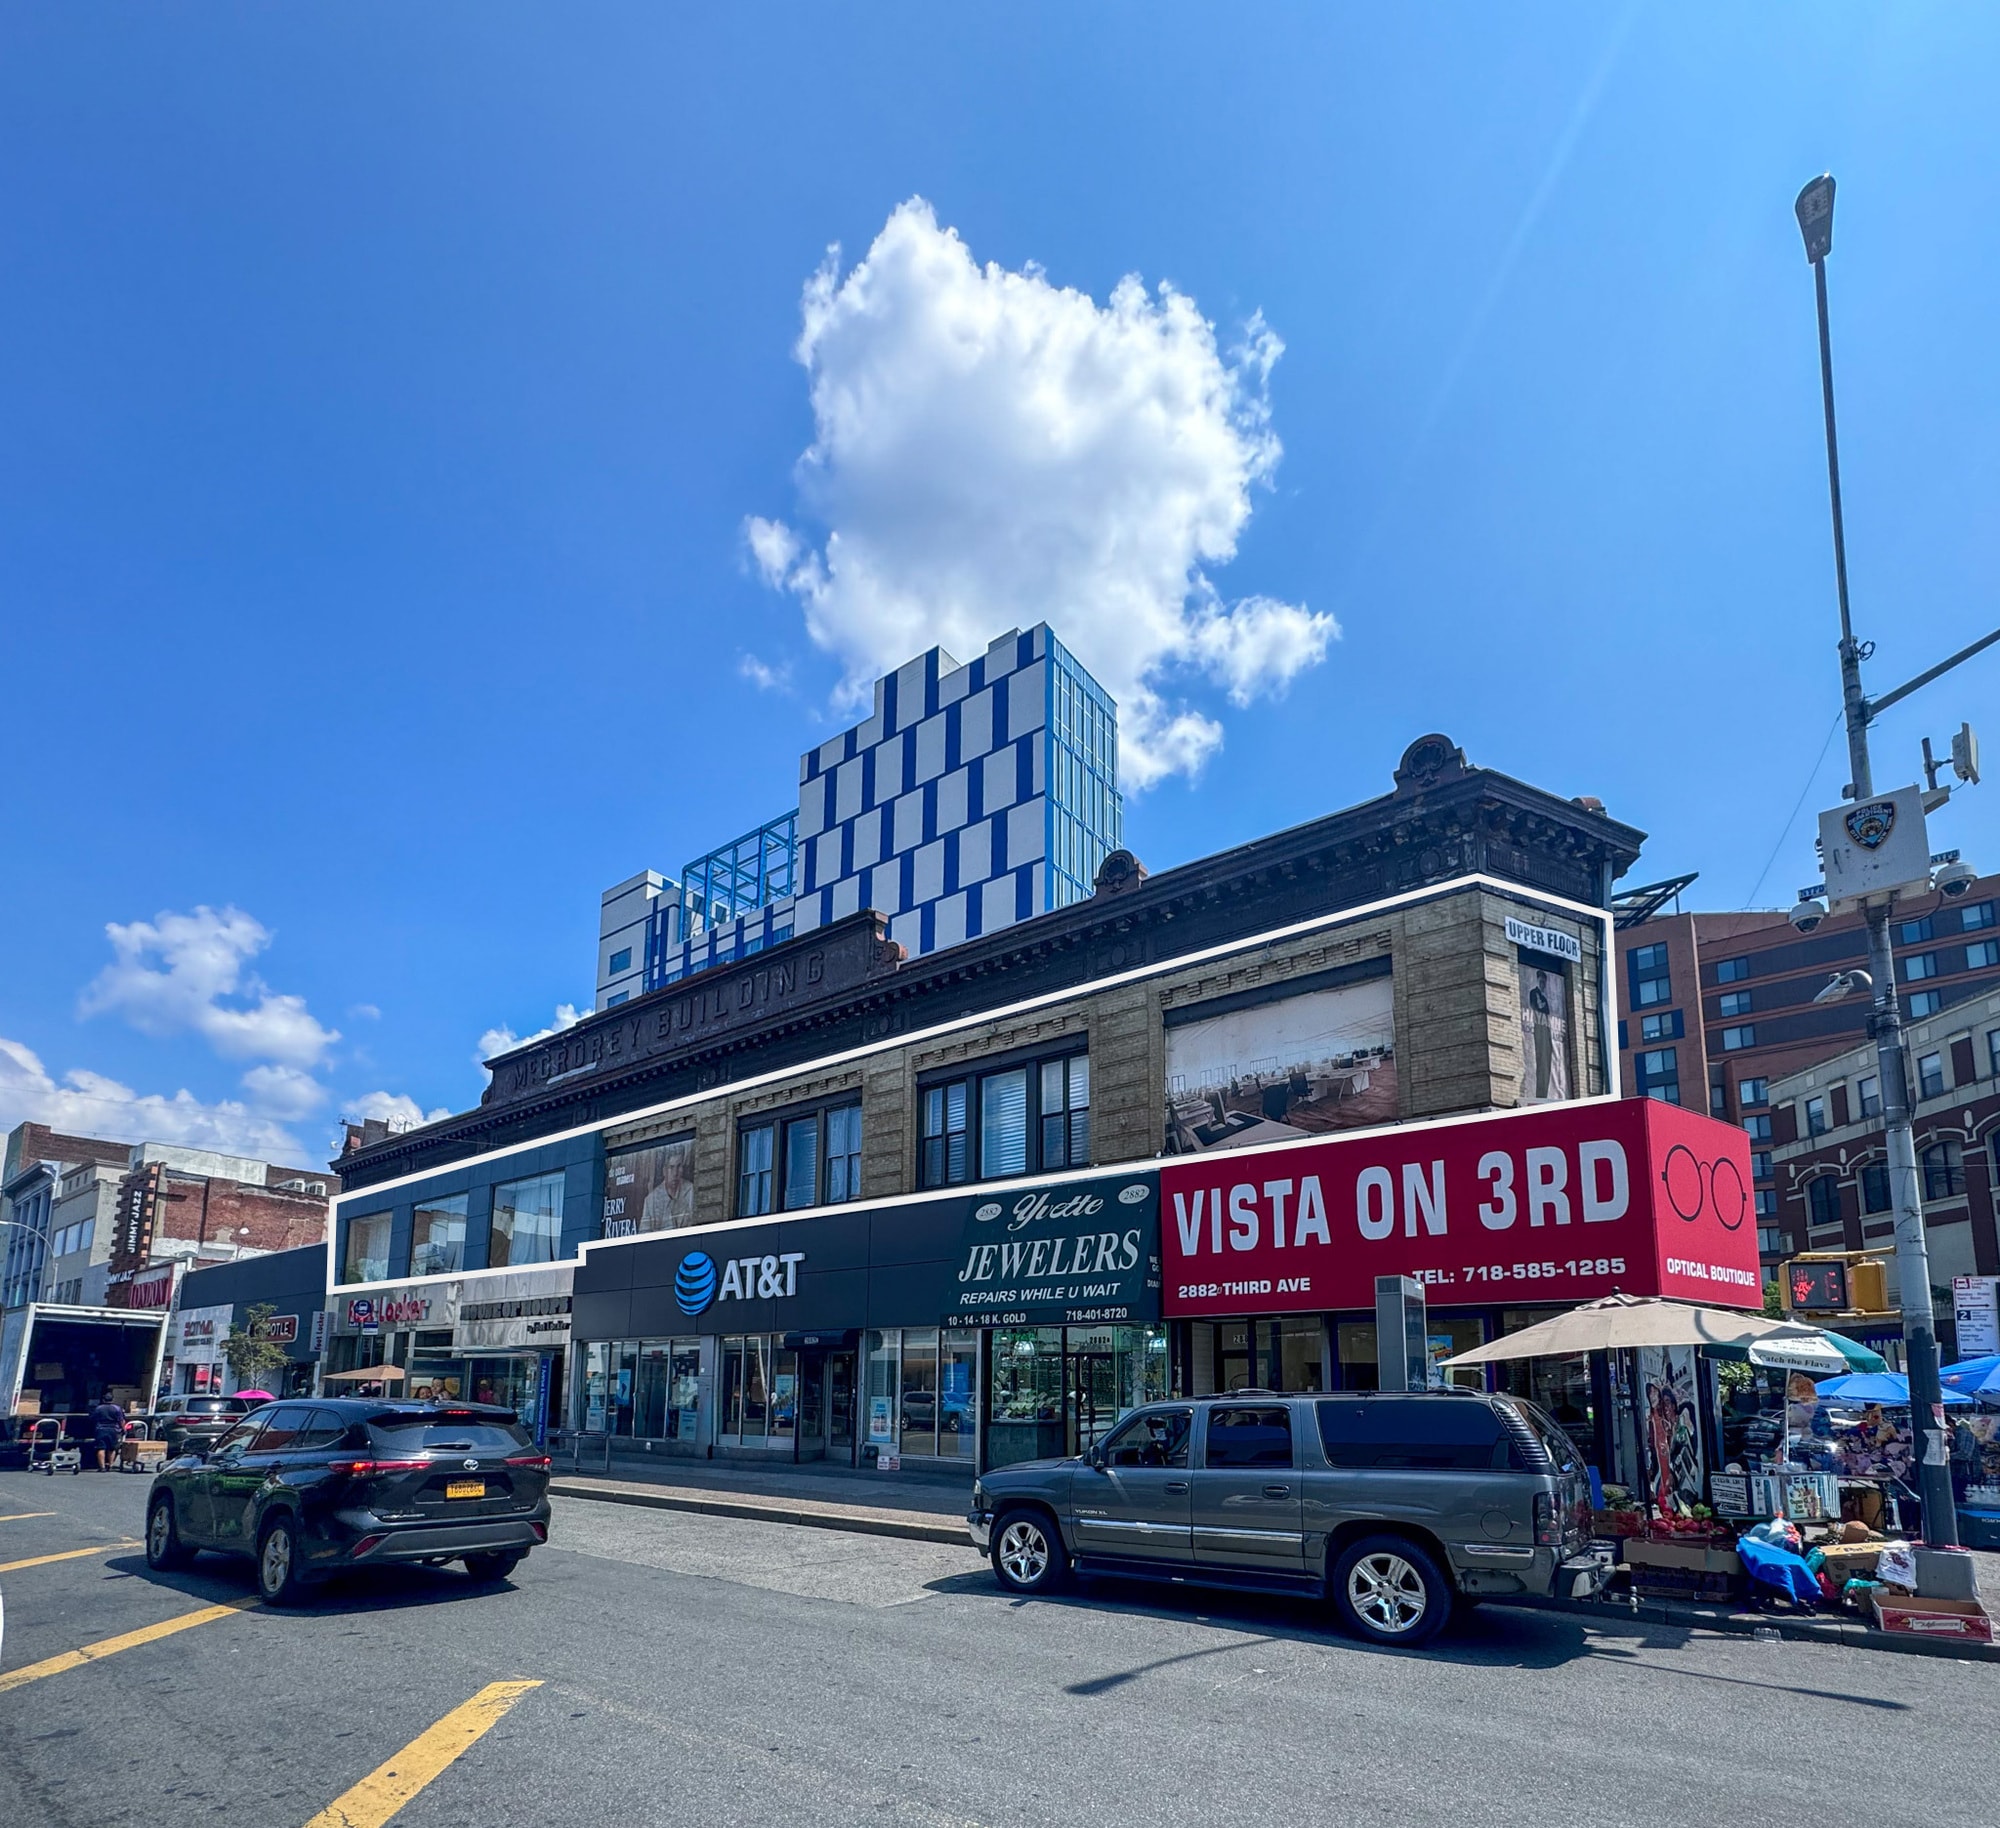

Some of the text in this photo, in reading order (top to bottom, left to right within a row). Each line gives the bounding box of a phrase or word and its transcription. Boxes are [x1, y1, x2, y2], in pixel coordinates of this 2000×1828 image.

[1931, 850, 1958, 863] NYPD
[1800, 885, 1825, 898] NYPD
[1508, 920, 1578, 958] UPPER FLOOR
[657, 950, 825, 1038] BUILDING
[1123, 1188, 1147, 1201] 2882
[1173, 1138, 1630, 1257] VISTA ON 3RD
[127, 1190, 142, 1254] JIMMY JAZZ
[601, 1196, 627, 1222] JERRY
[979, 1206, 999, 1217] 2882
[1007, 1192, 1104, 1232] Yvette
[605, 1217, 637, 1239] RIVERA
[958, 1228, 1142, 1283] JEWELERS
[718, 1252, 806, 1301] AT&T
[1412, 1257, 1627, 1286] TEL: 718-585-1285
[1666, 1257, 1756, 1287] OPTICAL BOUTIQUE
[960, 1282, 1121, 1305] REPAIRS WHILE U WAIT
[1178, 1277, 1311, 1298] 2882 THIRD AVE
[379, 1293, 427, 1322] Locker
[948, 1316, 957, 1326] 10
[963, 1315, 973, 1325] 14
[981, 1314, 990, 1324] 18
[1002, 1312, 1027, 1324] GOLD
[1065, 1307, 1128, 1321] 718-401-8720
[1959, 1310, 1968, 1320] 2
[315, 1312, 324, 1350] Foot Locker
[1759, 1354, 1831, 1369] Catch the Flava
